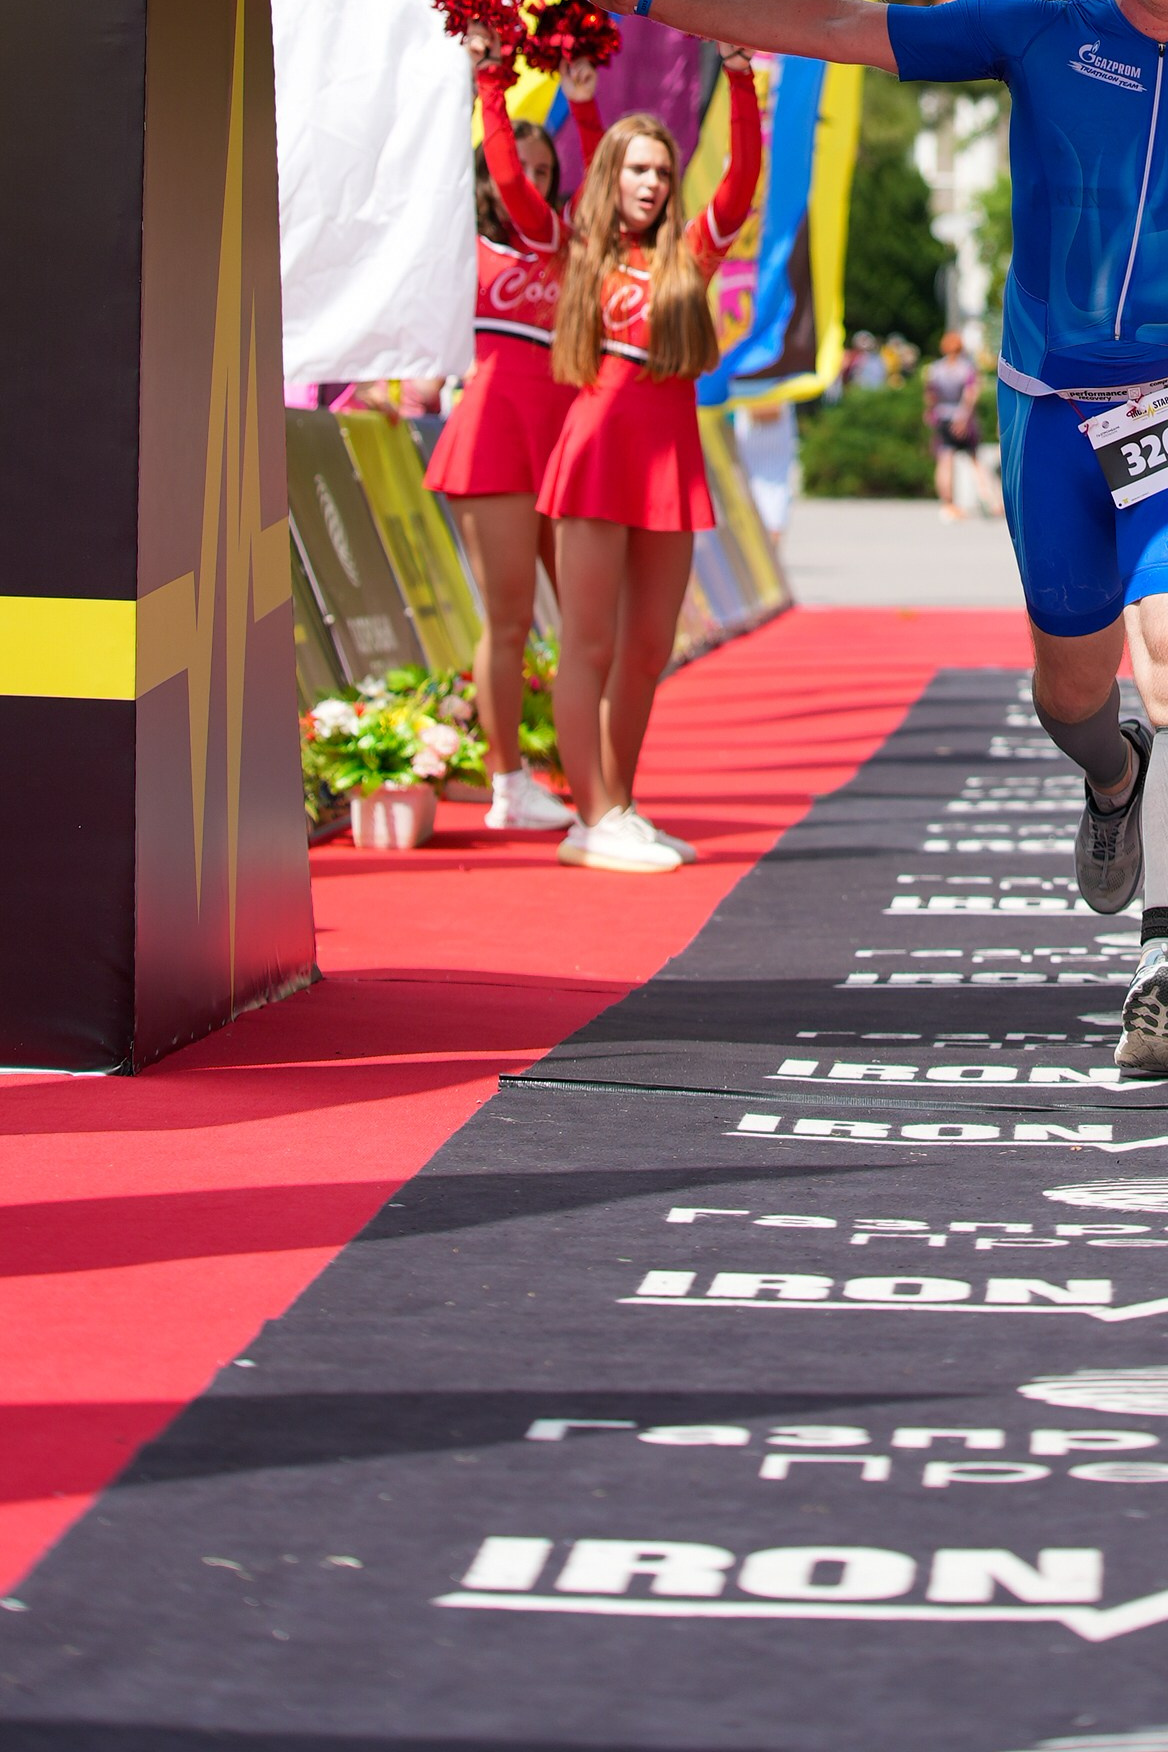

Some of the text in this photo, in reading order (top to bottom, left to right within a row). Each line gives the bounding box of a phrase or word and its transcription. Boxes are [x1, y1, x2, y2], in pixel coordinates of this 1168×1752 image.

[1080, 65, 1139, 90] TRIATHLON TEAM
[1094, 56, 1142, 79] GAZPROM
[1069, 389, 1128, 398] performance
[775, 1059, 1121, 1084] IRON
[737, 1113, 1113, 1142] IRON
[635, 1270, 1113, 1305] IRON
[461, 1536, 1104, 1603] IRON
